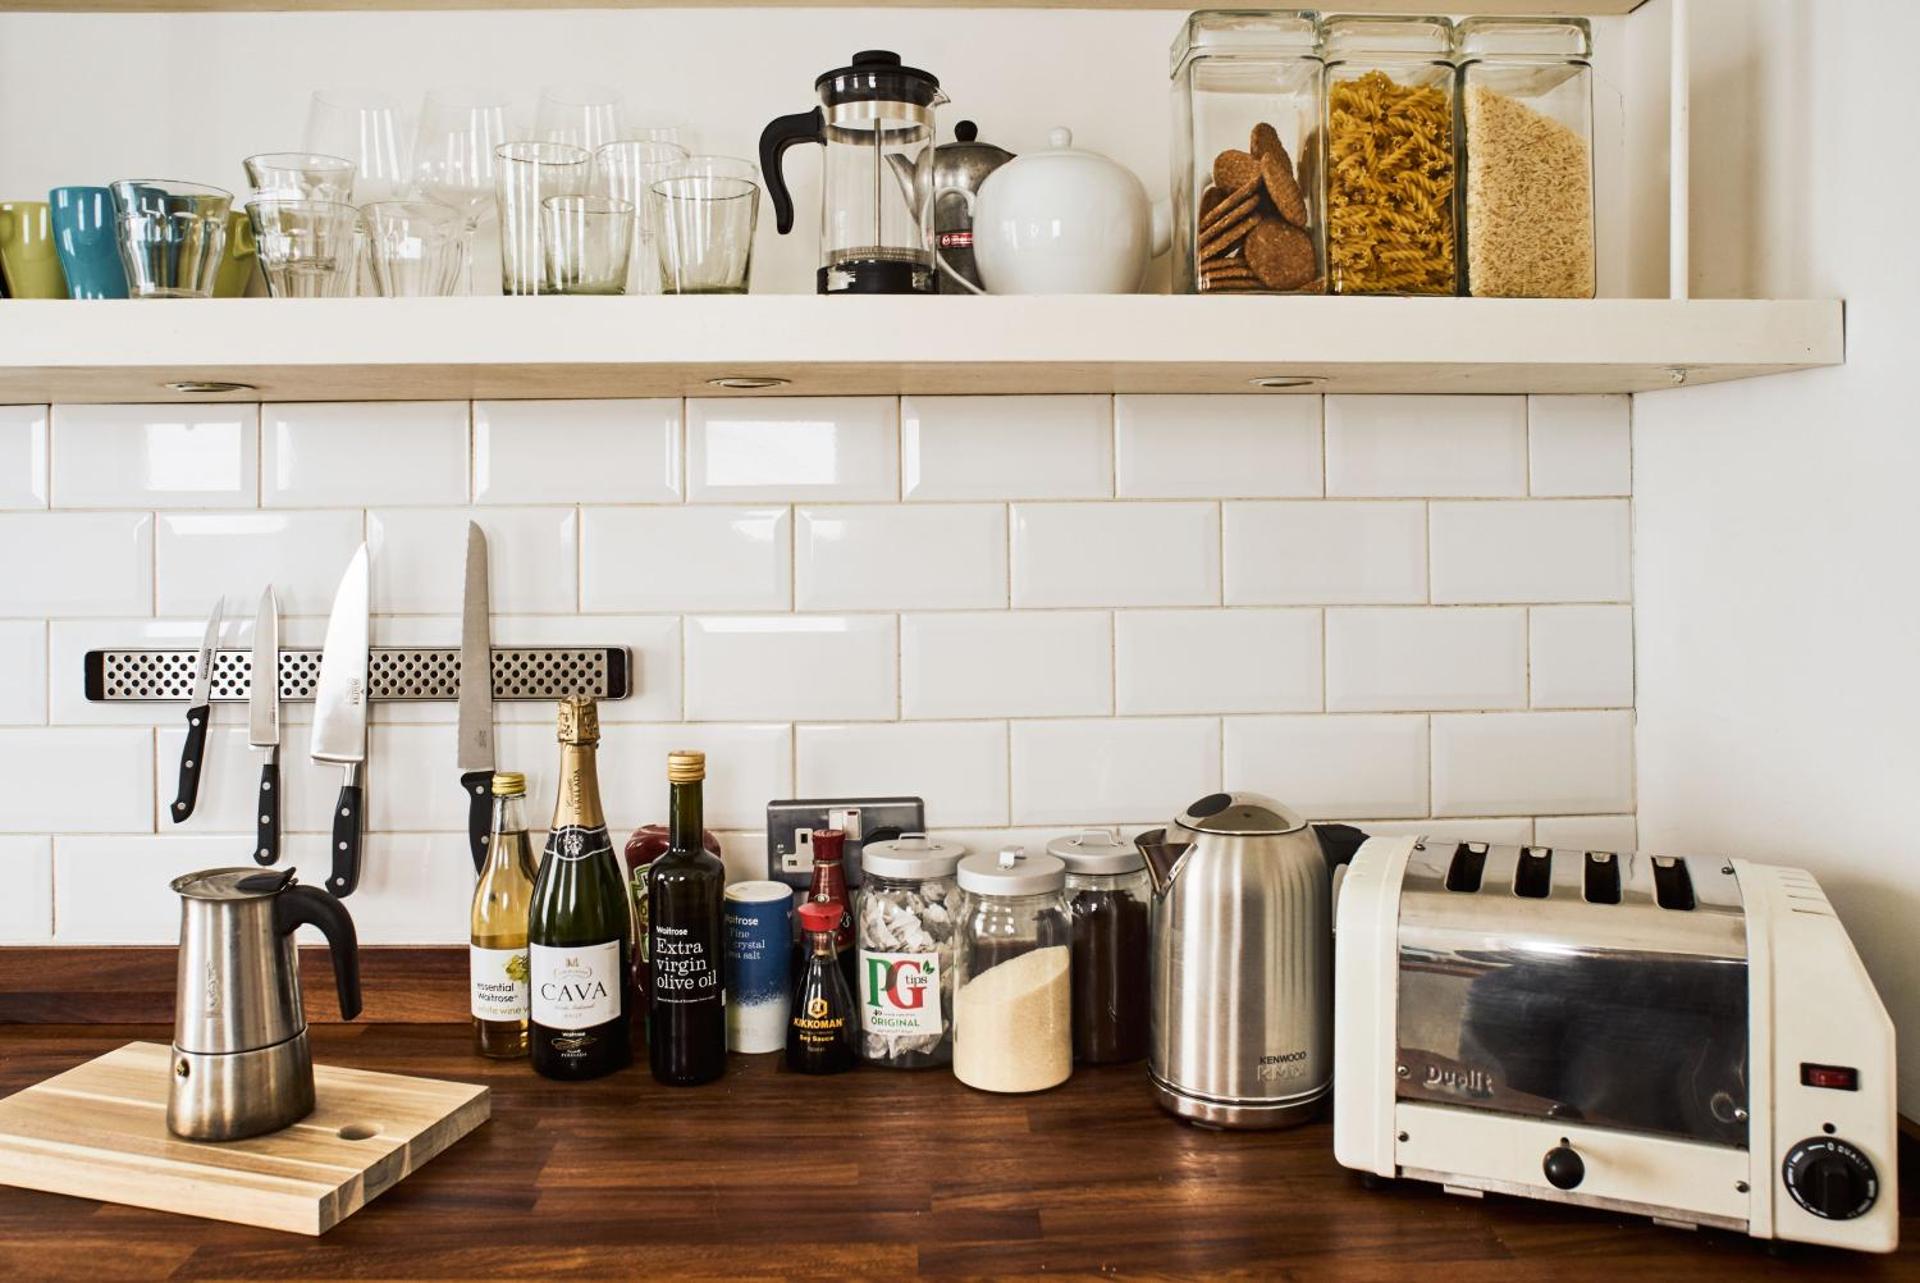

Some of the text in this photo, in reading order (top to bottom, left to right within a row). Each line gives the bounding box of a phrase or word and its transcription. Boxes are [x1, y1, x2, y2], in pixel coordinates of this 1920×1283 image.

[656, 926, 688, 936] Waitrose
[656, 937, 703, 955] Extra
[743, 951, 760, 960] salt
[656, 957, 707, 977] virgin
[656, 969, 717, 990] olive oil
[866, 957, 928, 1010] PG tips
[540, 980, 608, 1002] CAVA
[478, 992, 514, 1003] Waitrose
[793, 1017, 843, 1029] KIKKOMAN
[871, 1016, 920, 1027] ORIGINAL
[799, 1034, 811, 1043] Soy
[1259, 1051, 1307, 1064] KENWOOD
